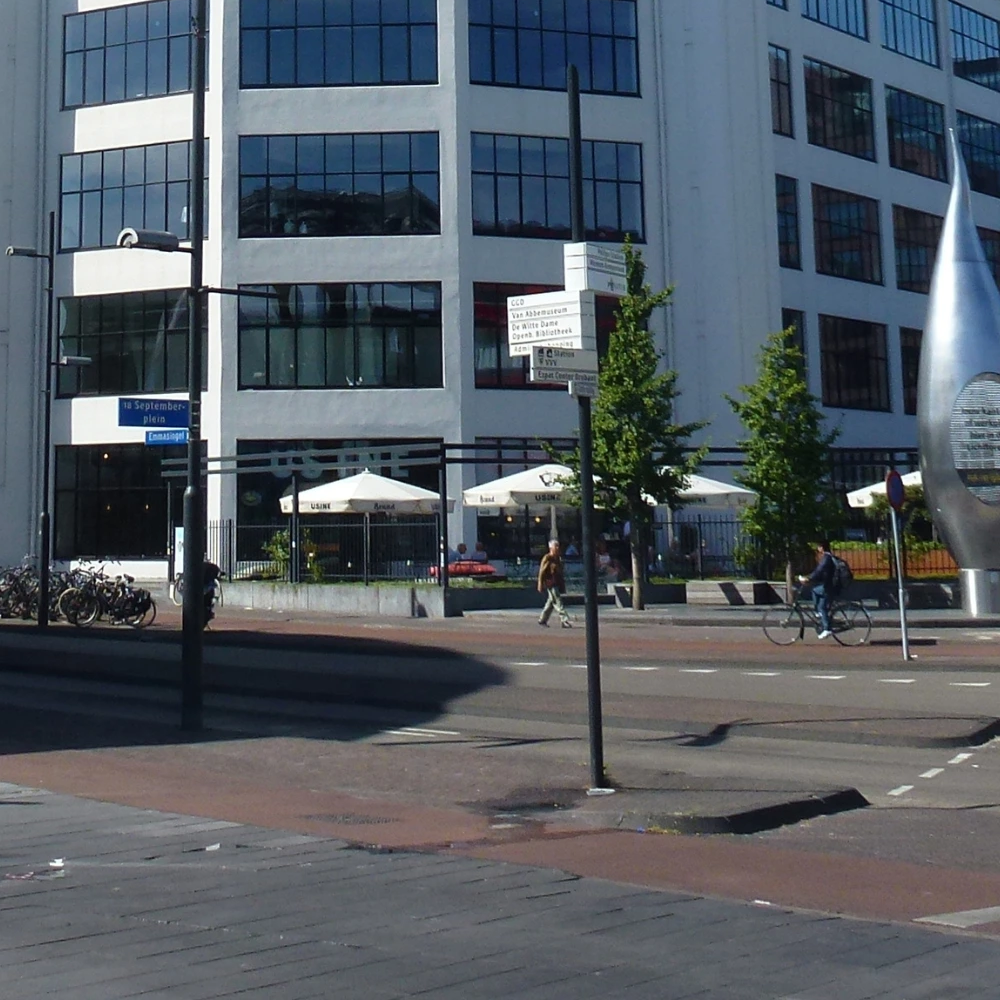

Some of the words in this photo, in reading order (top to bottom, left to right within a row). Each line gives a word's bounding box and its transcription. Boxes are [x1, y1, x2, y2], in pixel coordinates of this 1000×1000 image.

[511, 312, 525, 320] Van
[526, 307, 568, 318] Abbemuseum
[512, 323, 520, 331] De
[522, 321, 539, 330] Witte
[541, 319, 559, 328] Dame
[536, 327, 573, 338] Bibliotheek
[135, 400, 185, 411] September-
[143, 414, 166, 425] plein
[148, 431, 185, 441] Emmasingel
[310, 502, 332, 511] USINE
